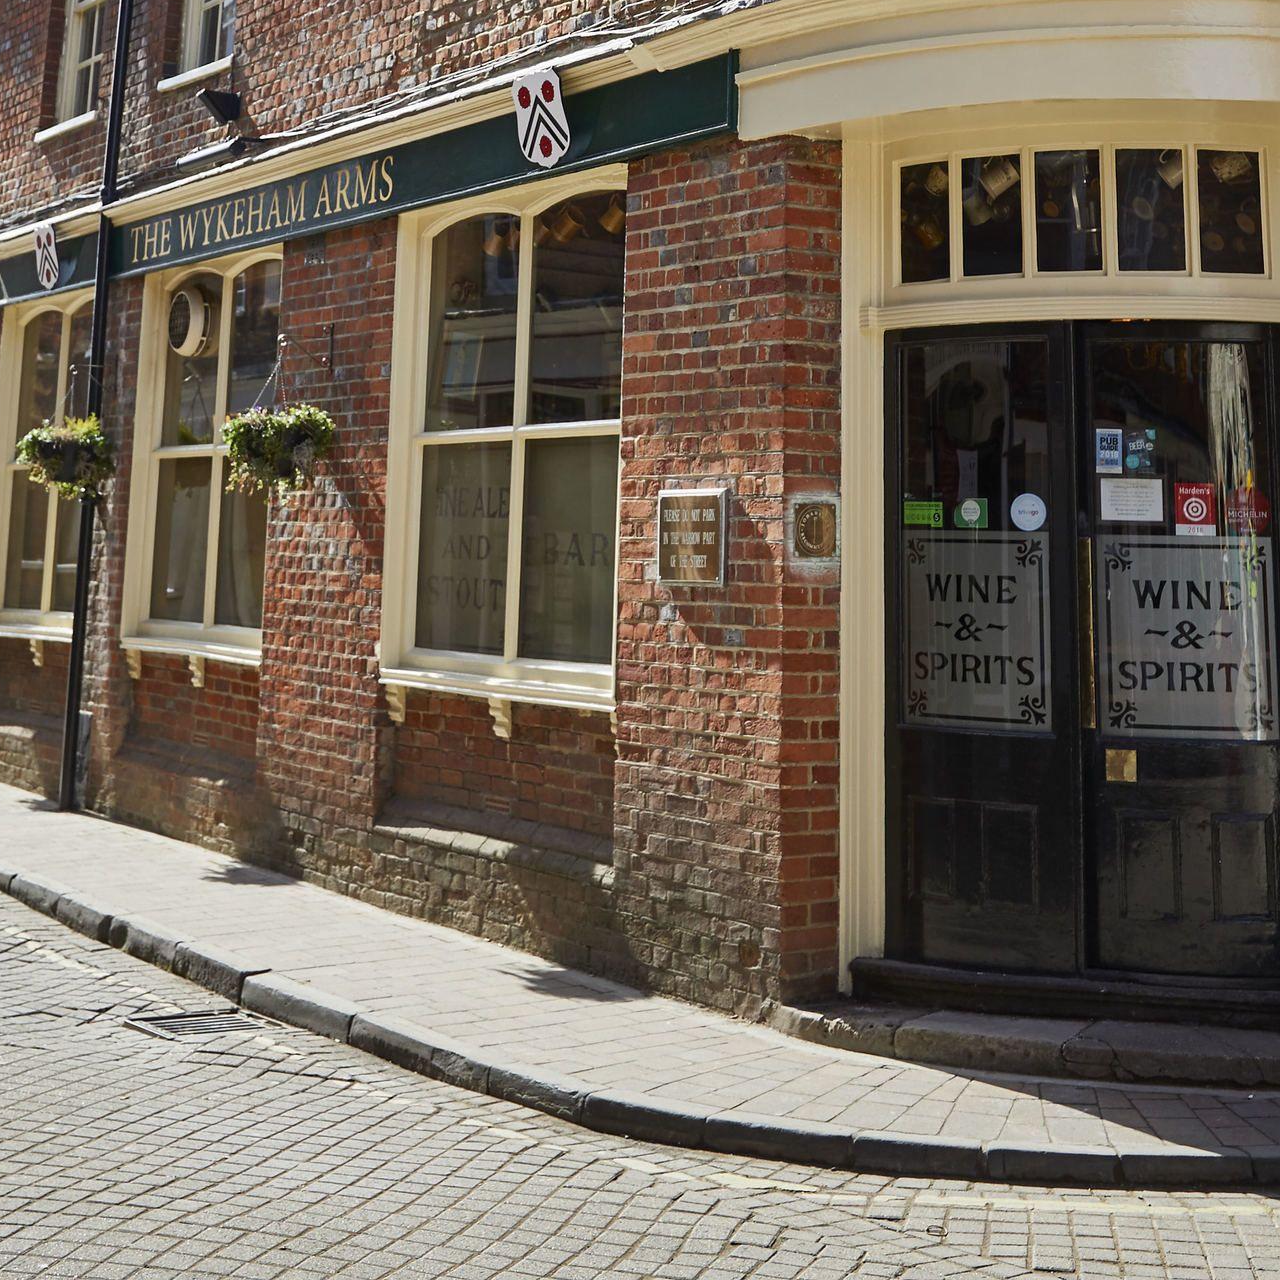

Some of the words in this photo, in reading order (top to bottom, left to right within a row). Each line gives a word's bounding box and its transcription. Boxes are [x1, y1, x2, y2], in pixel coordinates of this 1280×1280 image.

[131, 217, 172, 263] THE
[179, 179, 309, 251] WYKEHAM
[314, 155, 394, 218] ARMS
[1100, 437, 1119, 445] PUB
[1179, 487, 1211, 495] Harden's
[702, 508, 716, 522] PARK
[1228, 510, 1268, 518] MICHELIN
[441, 535, 491, 561] AND
[543, 531, 610, 567] BAR
[926, 573, 1018, 604] WINE
[1132, 579, 1242, 611] WINE
[914, 651, 1036, 686] SPIRITS
[1118, 660, 1262, 694] SPIRITS
